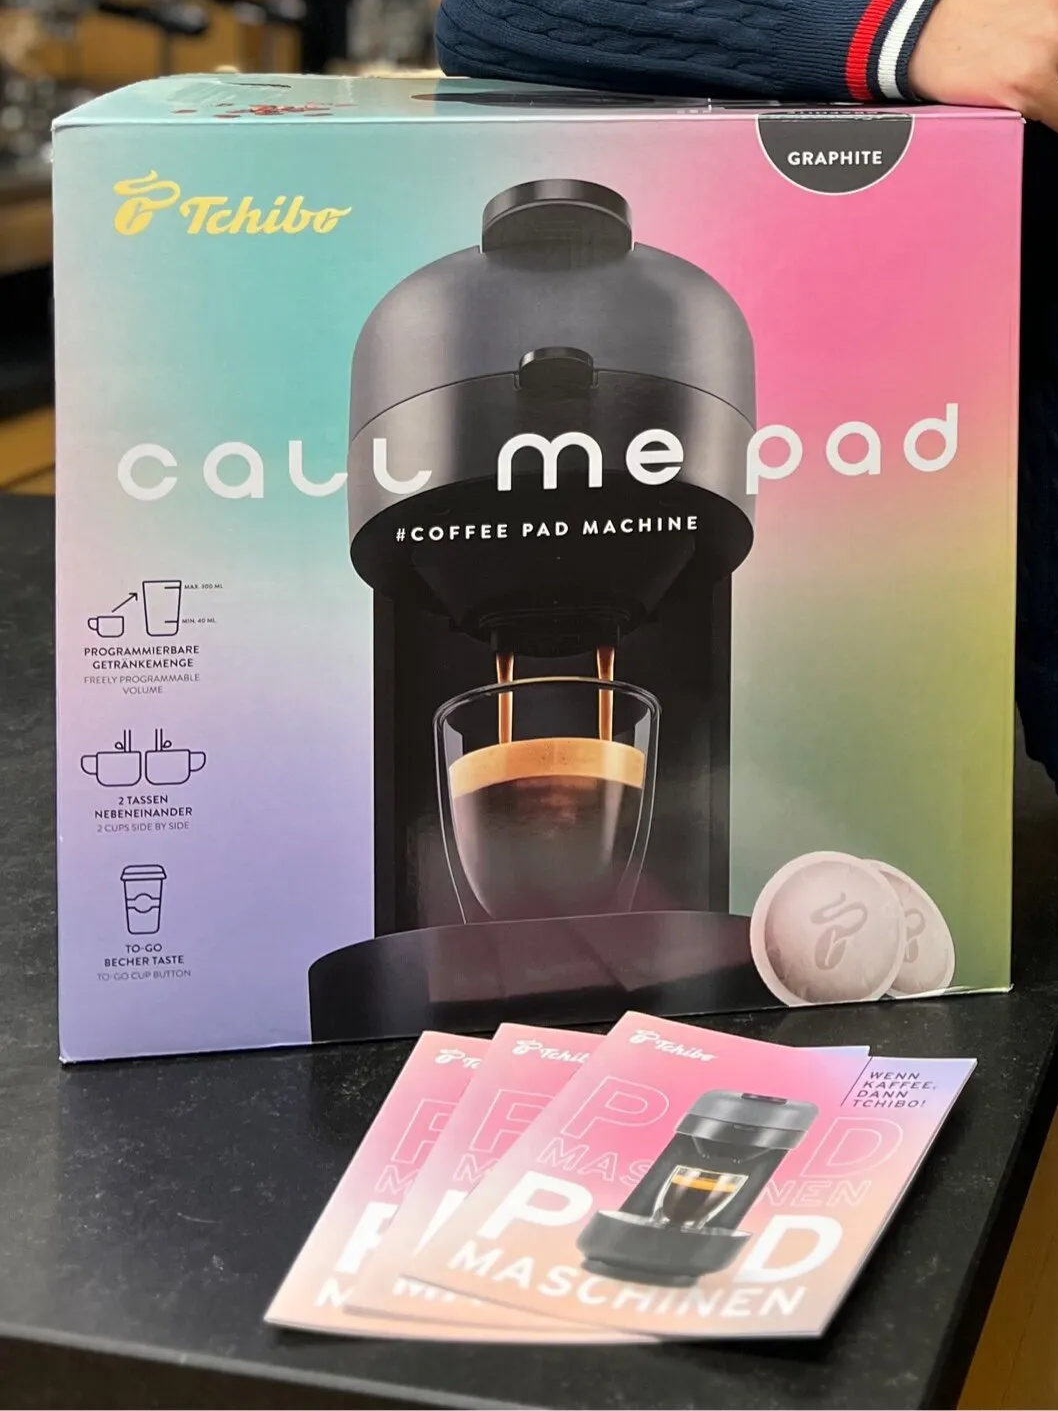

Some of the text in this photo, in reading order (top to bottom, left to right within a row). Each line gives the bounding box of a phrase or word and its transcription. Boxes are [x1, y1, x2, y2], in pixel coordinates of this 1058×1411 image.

[787, 150, 883, 166] GRAPHITE
[179, 195, 353, 235] Tchibo
[117, 402, 959, 501] call me pad
[396, 514, 699, 543] #COFFEE PAD MACHINE
[84, 645, 200, 657] PROGRAMMIERBARE
[92, 657, 194, 670] GETRÄNKEMENGE
[84, 673, 200, 685] FREELY PROGRAMMABLE
[122, 685, 163, 695] VOLUME
[118, 794, 168, 805] 2 TASSEN
[94, 807, 193, 819] NEBENEINANDER
[97, 821, 190, 833] 2 CUPS SIDE BY SIDE
[125, 943, 163, 954] TO-GO
[104, 954, 185, 967] BECHER TASTE
[97, 969, 192, 981] TO-GO CUP BUTTON
[655, 1039, 717, 1061] Tchibo
[870, 1071, 921, 1080] WENN
[856, 1090, 908, 1099] DANN
[852, 1099, 927, 1109] TCHIBO!
[447, 1239, 809, 1319] MASCHINEN
